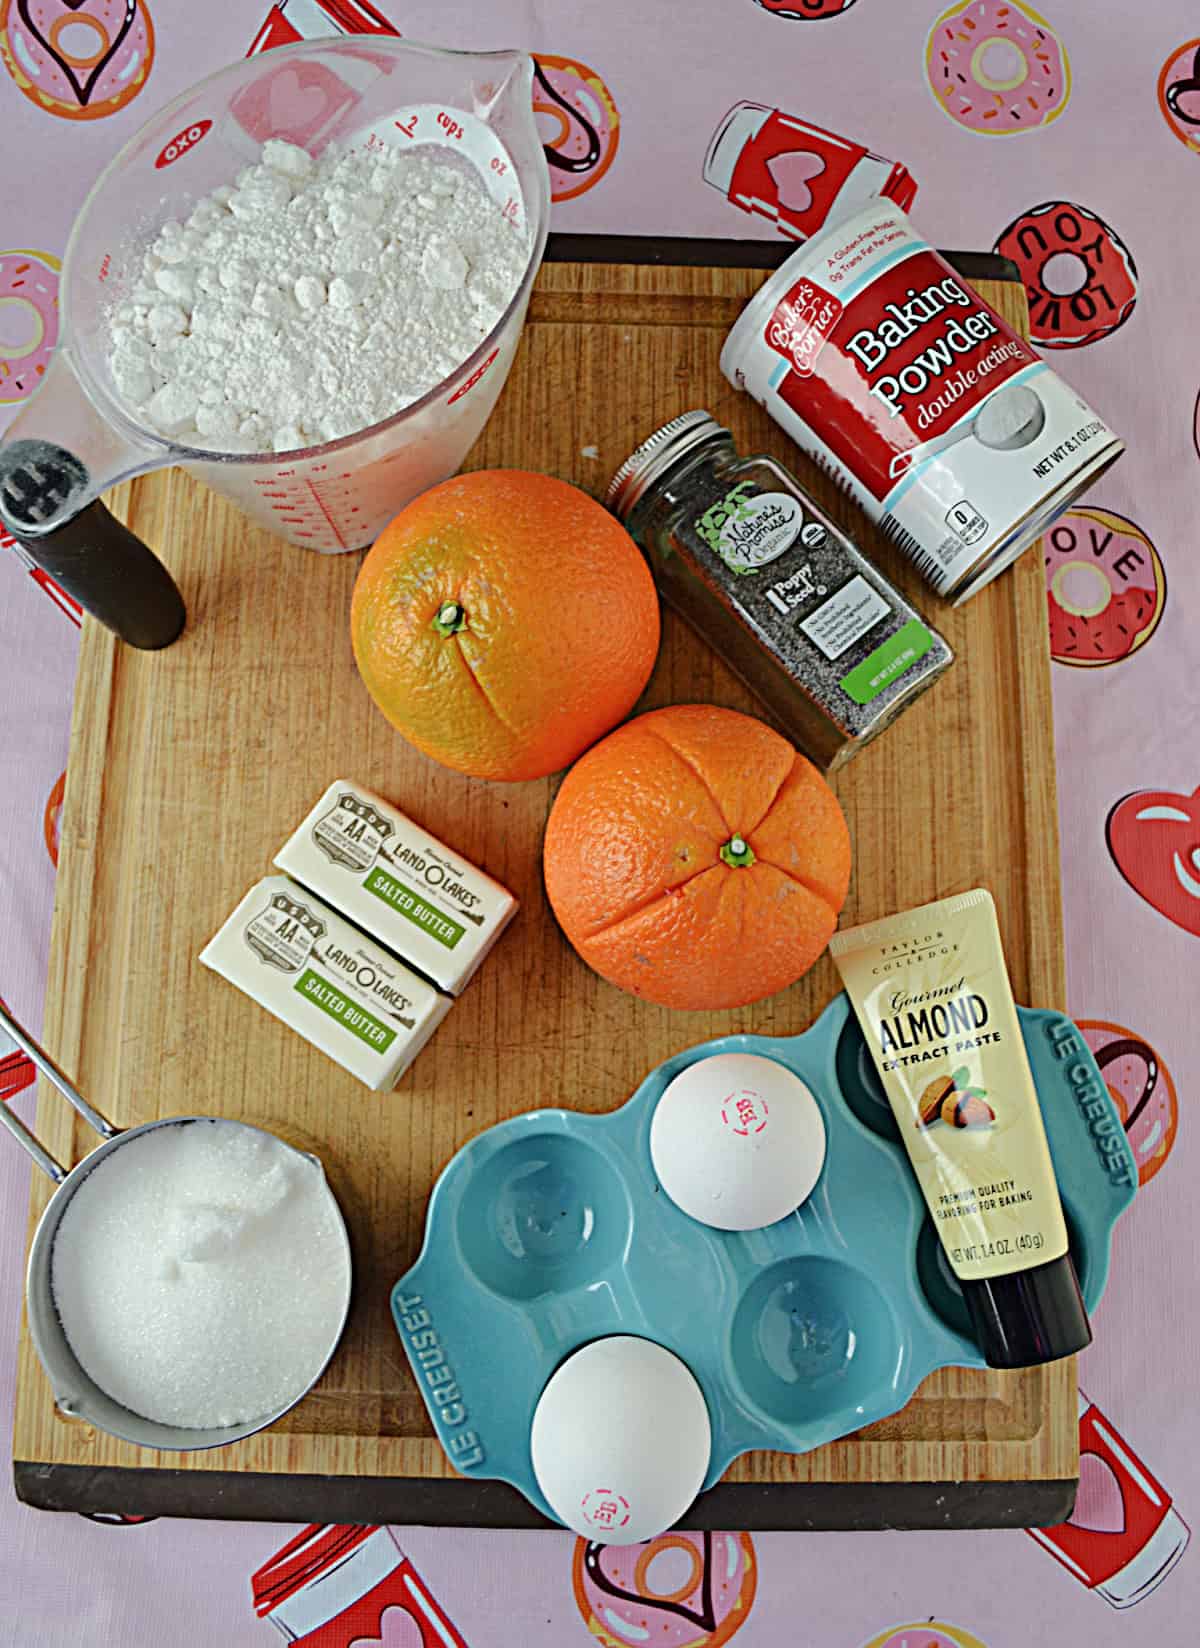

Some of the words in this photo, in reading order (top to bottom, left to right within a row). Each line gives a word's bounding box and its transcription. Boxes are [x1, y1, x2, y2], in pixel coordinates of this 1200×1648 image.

[164, 127, 201, 161] OXO
[437, 112, 464, 139] cups
[490, 157, 507, 176] oz
[840, 255, 863, 271] Trans
[860, 245, 874, 256] Fat
[1016, 212, 1104, 264] YOU
[827, 259, 836, 269] A
[769, 284, 814, 347] Baker's
[791, 298, 835, 370] Corner
[845, 277, 971, 373] Baking
[868, 311, 998, 418] Powder
[917, 369, 979, 430] double
[976, 341, 1026, 376] acting
[1032, 457, 1054, 478] NET
[1049, 445, 1069, 463] WT
[1064, 436, 1082, 452] 8.1
[1076, 428, 1091, 442] OZ
[727, 503, 783, 543] Nature's
[735, 510, 795, 562] Promise
[954, 510, 968, 525] 0
[1045, 526, 1145, 580] OVE
[774, 563, 813, 597] Poppy
[785, 574, 816, 608] Seed
[343, 818, 368, 842] AA
[393, 843, 427, 872] LAND
[441, 877, 478, 908] LAKES
[373, 876, 415, 911] SALTED
[412, 904, 457, 939] BUTTER
[275, 918, 300, 943] AA
[881, 931, 943, 955] TAYLOR
[325, 943, 358, 973] LAND
[373, 980, 410, 1012] LAKES
[872, 944, 958, 975] COLLEDGE
[304, 979, 346, 1013] SALTED
[343, 1007, 387, 1044] BUTTER
[889, 976, 965, 1016] Gourmet
[880, 994, 989, 1055] ALMOND
[882, 1046, 949, 1072] EXTRACT
[955, 1031, 1002, 1052] PASTE
[1048, 1018, 1081, 1060] LE
[1068, 1062, 1136, 1187] CREUSET
[938, 1188, 976, 1204] PREMIUM
[978, 1180, 1015, 1197] QUALITY
[979, 1199, 997, 1212] FOR
[998, 1190, 1033, 1208] BAKING
[1015, 1232, 1045, 1253] (40g)
[396, 1295, 467, 1427] CREUSET
[451, 1430, 484, 1469] LE
